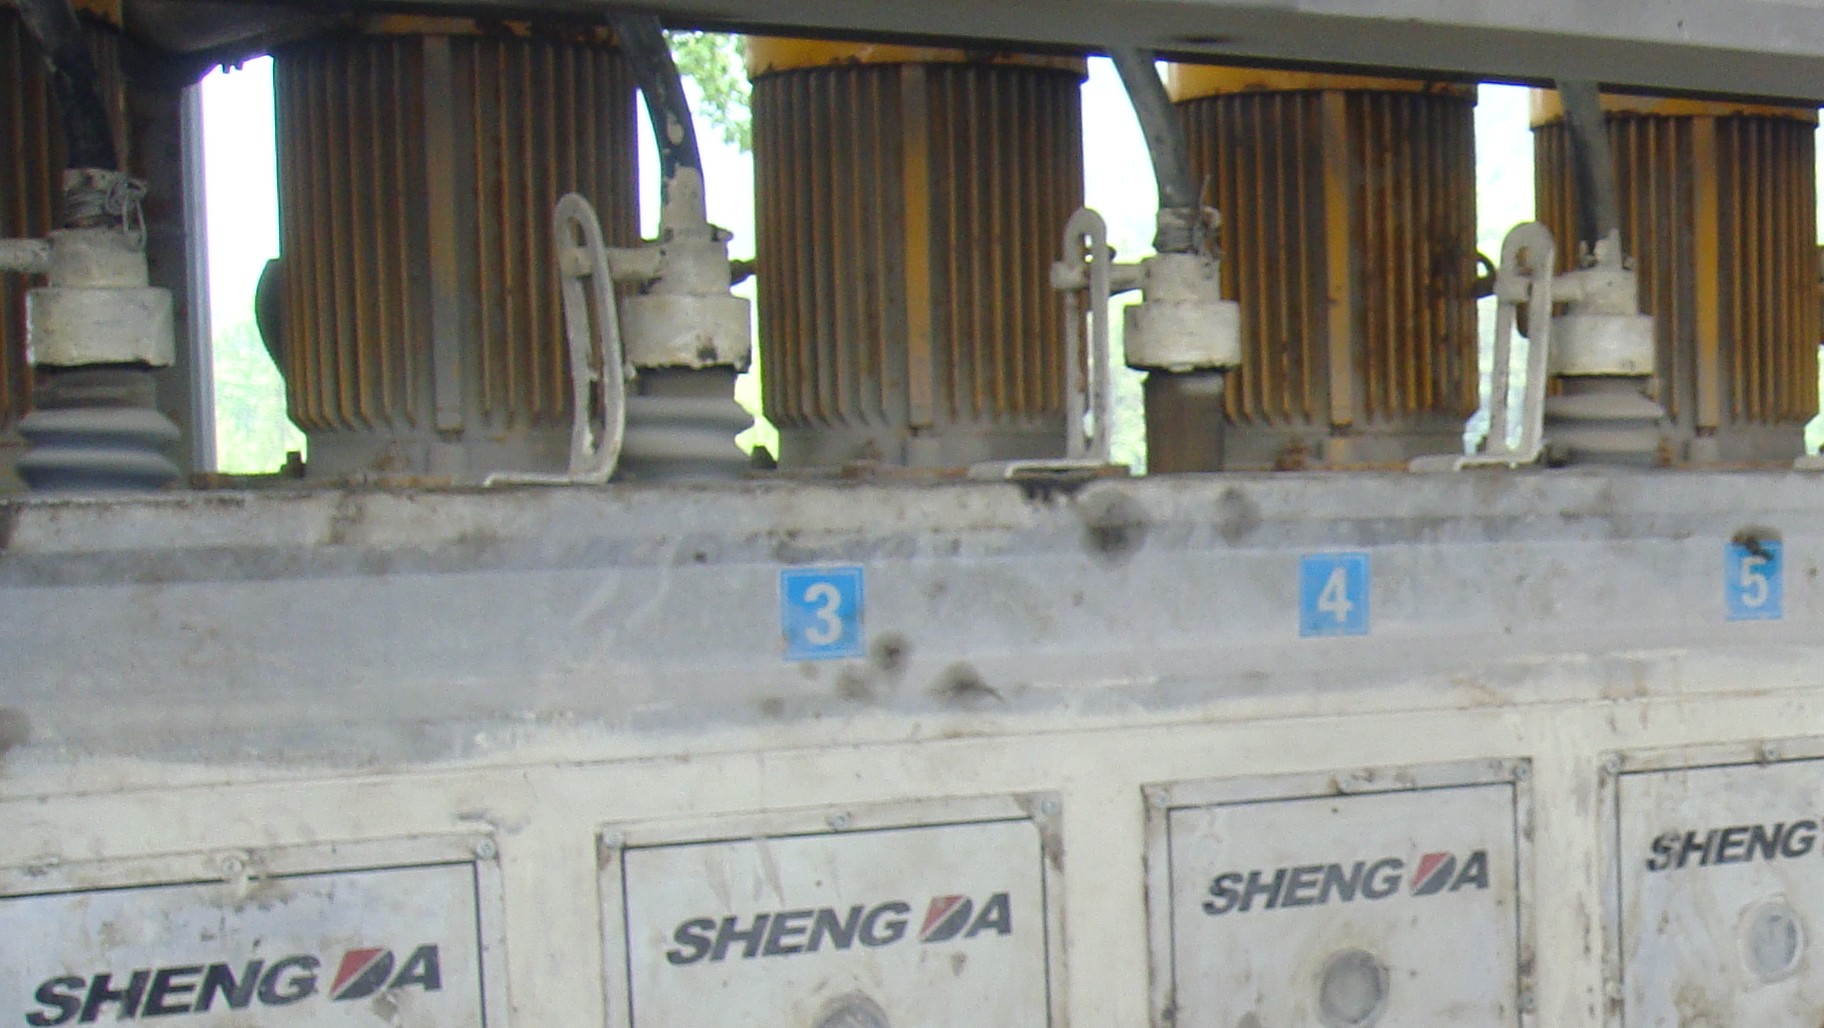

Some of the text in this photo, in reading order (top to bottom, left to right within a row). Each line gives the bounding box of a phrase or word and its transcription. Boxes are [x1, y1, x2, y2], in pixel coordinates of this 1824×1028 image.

[1317, 566, 1353, 623] 4
[1742, 554, 1769, 609] 5
[804, 582, 842, 647] 3
